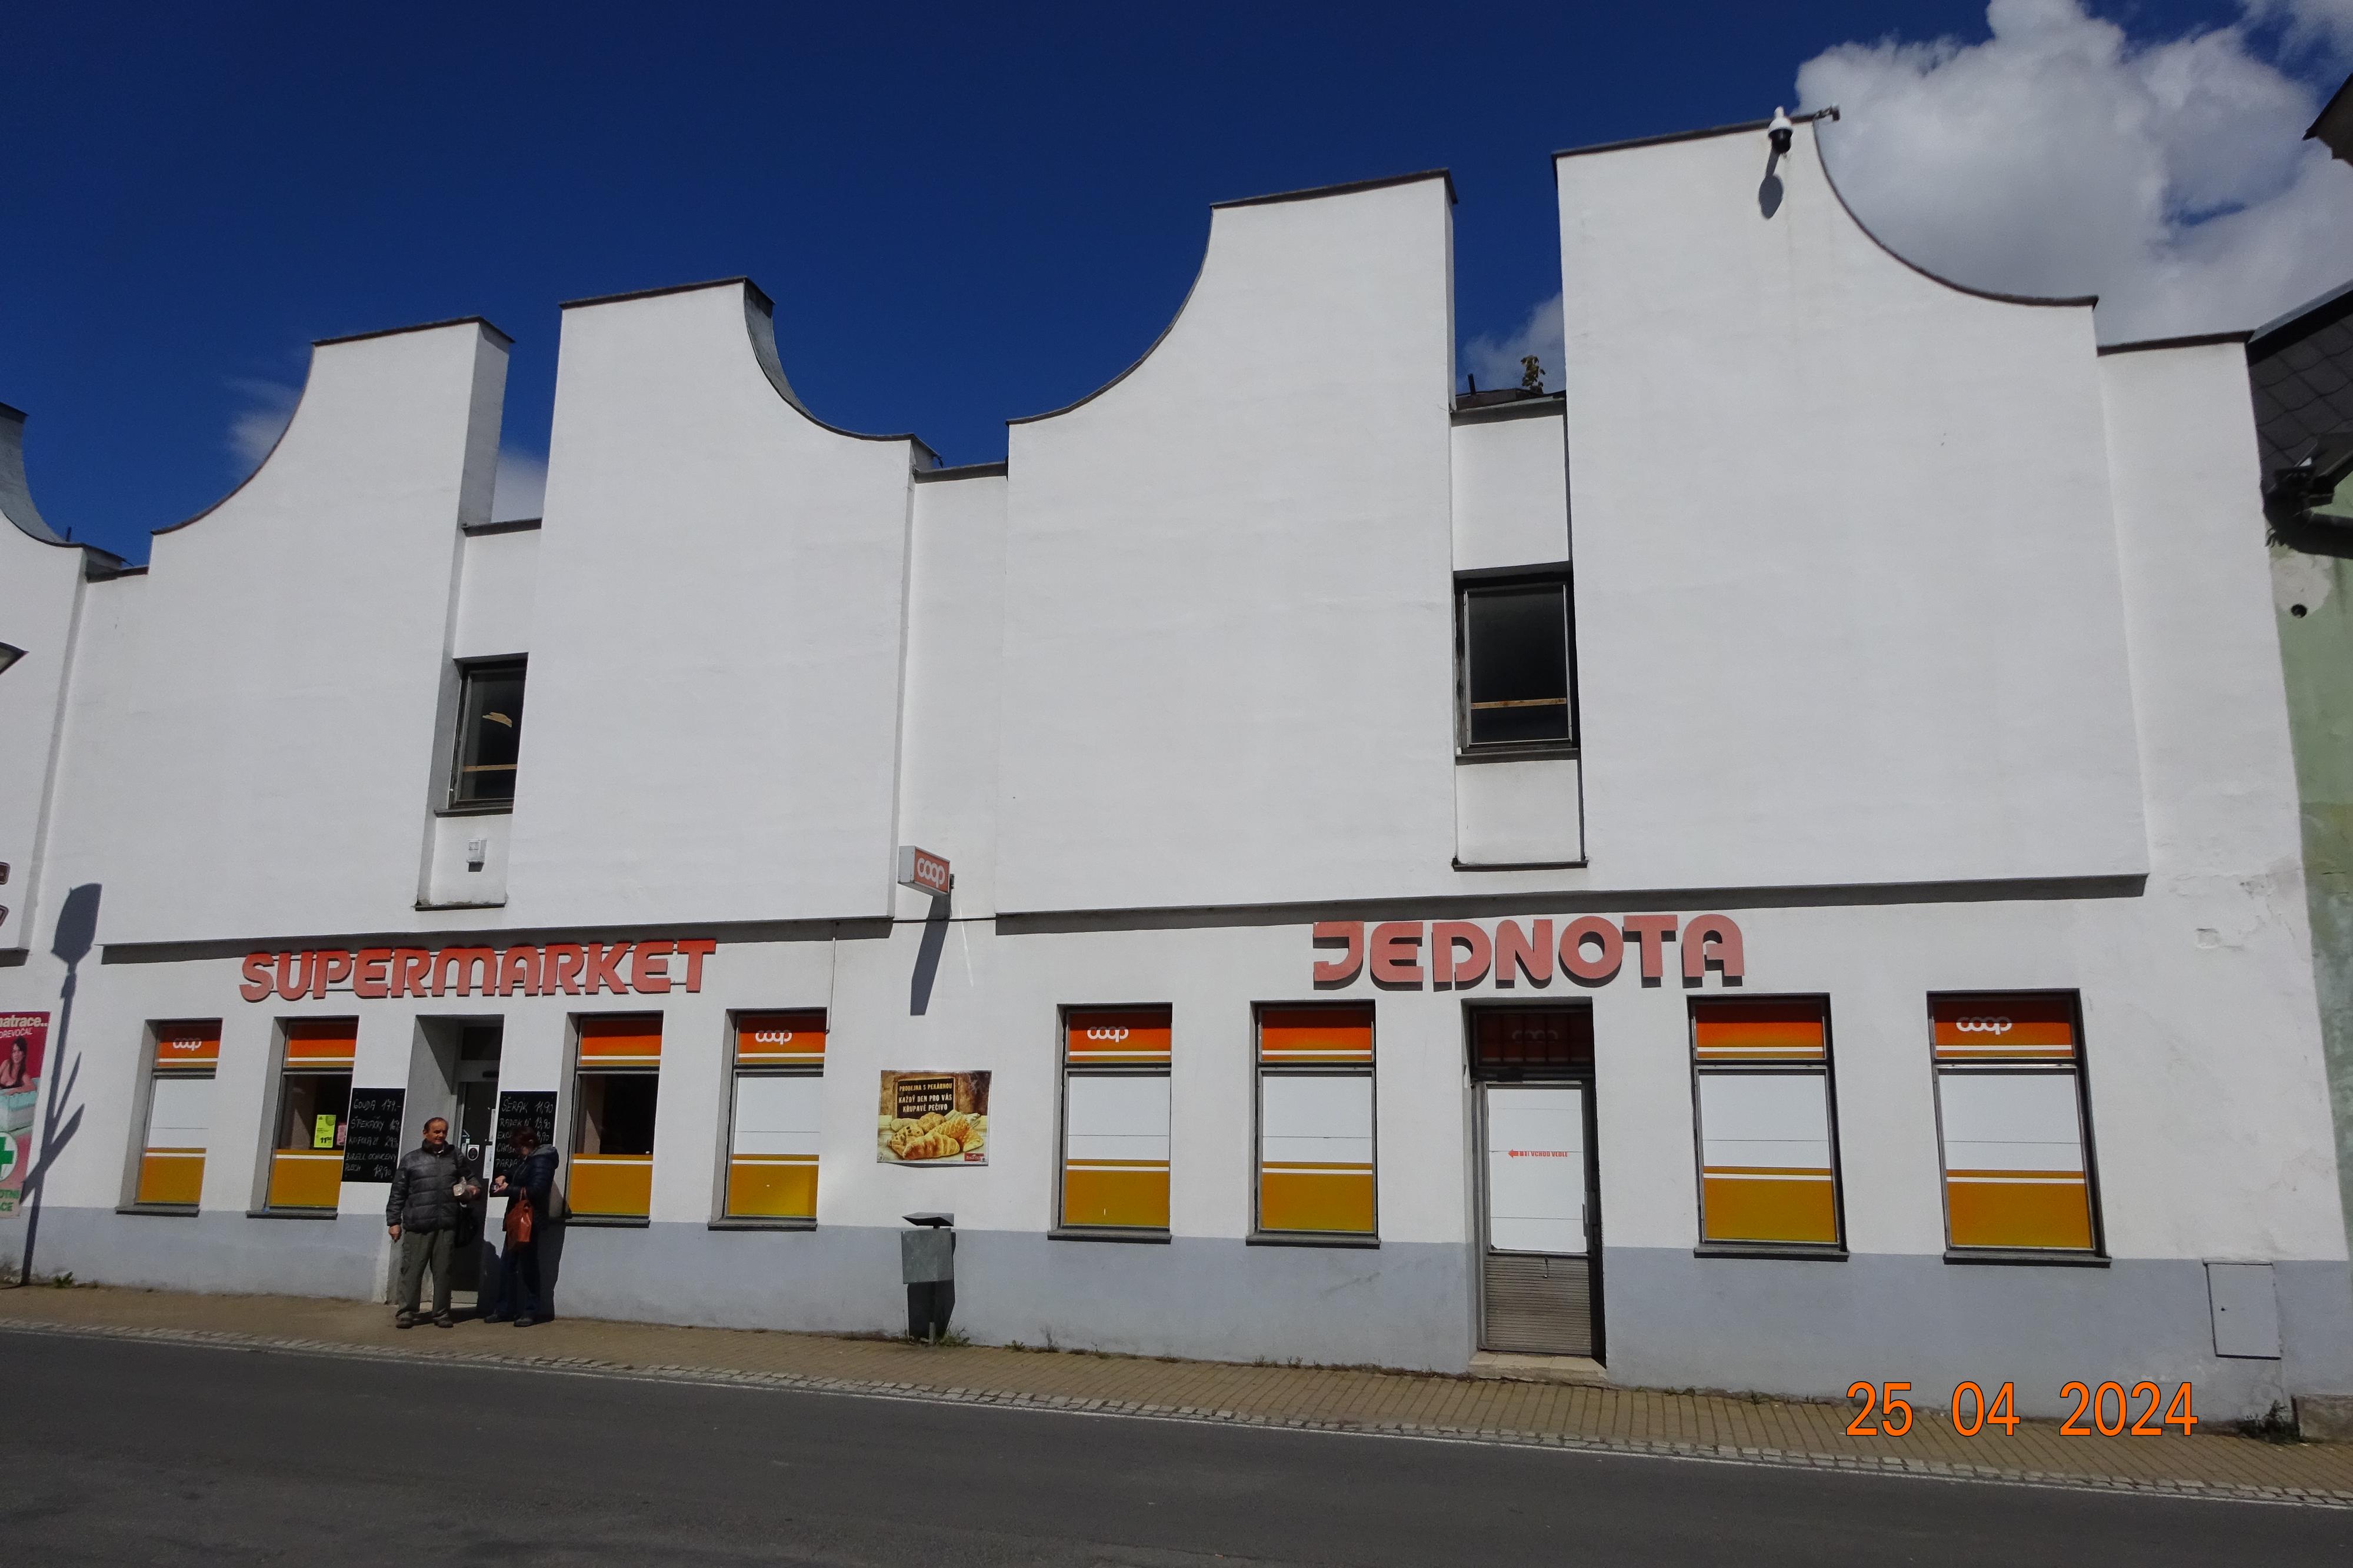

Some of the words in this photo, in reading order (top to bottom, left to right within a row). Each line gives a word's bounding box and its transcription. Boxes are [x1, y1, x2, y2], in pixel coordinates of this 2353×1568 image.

[917, 858, 946, 888] coop
[1313, 914, 1745, 982] JEDNOTA
[239, 940, 716, 1003] SUPERMARKET
[1956, 1016, 2012, 1035] coop
[755, 1030, 792, 1045] coop
[1087, 1026, 1129, 1043] coop
[172, 1037, 202, 1051] coop
[354, 1099, 376, 1110] GOUDA
[899, 1095, 915, 1103] KAŽDÝ
[941, 1093, 952, 1101] VÁS
[903, 1103, 926, 1113] KŘUPAVÉ
[928, 1103, 948, 1111] PEČIVO
